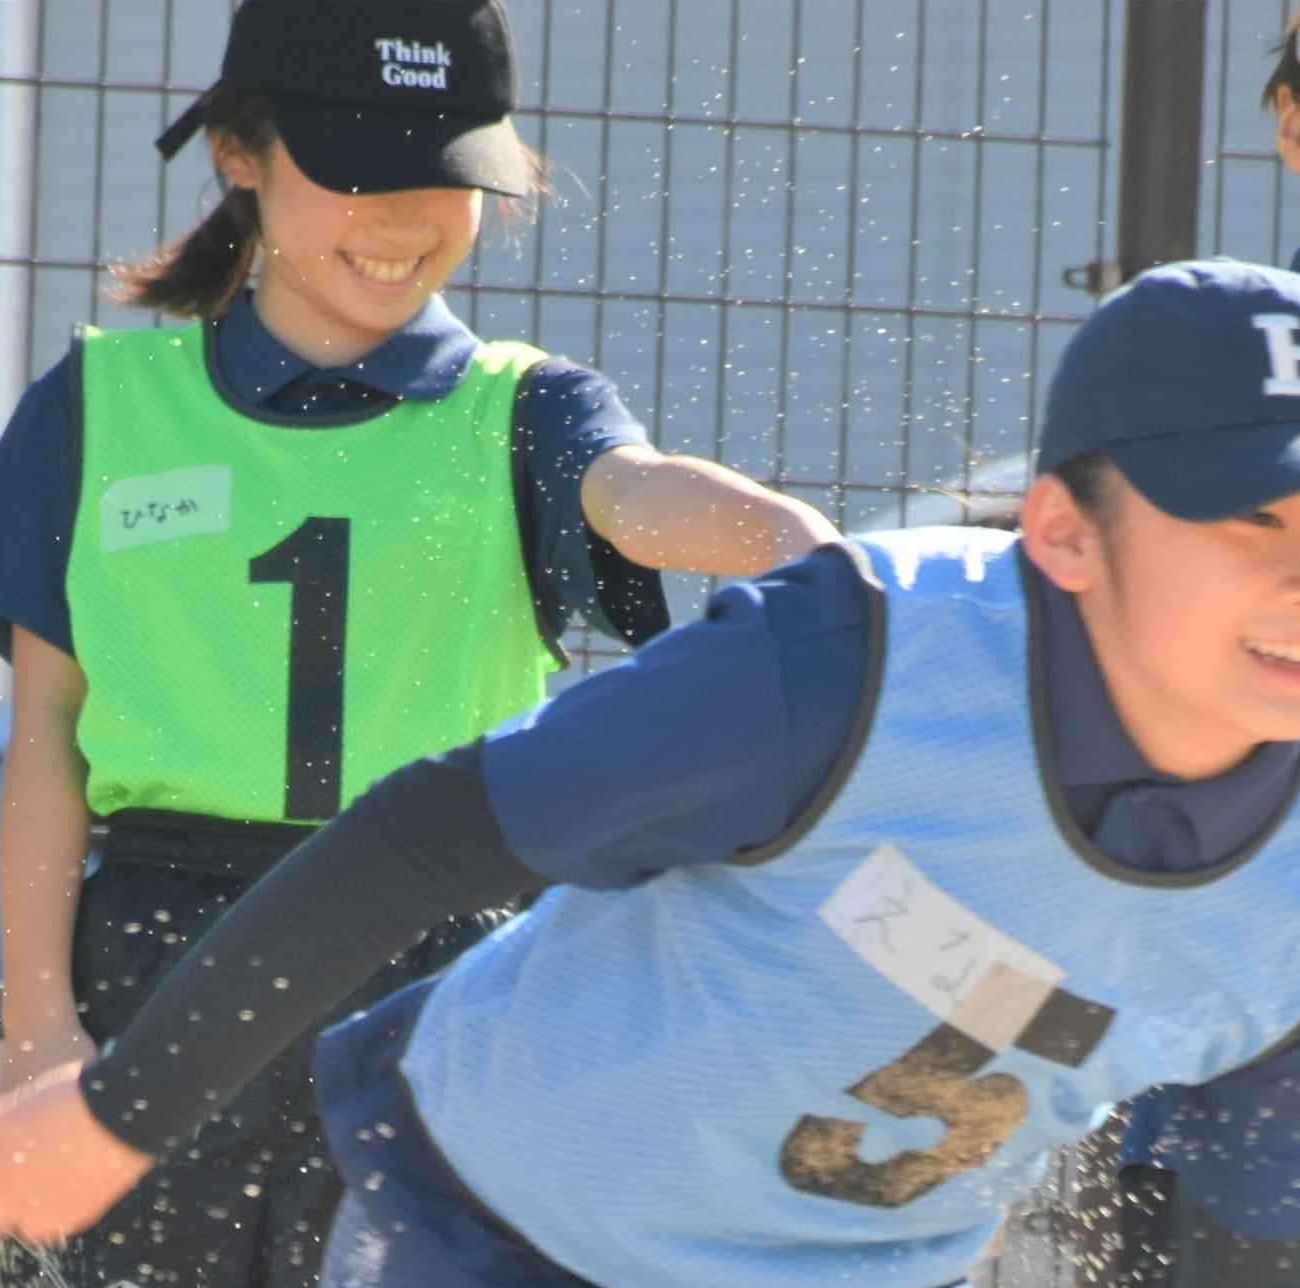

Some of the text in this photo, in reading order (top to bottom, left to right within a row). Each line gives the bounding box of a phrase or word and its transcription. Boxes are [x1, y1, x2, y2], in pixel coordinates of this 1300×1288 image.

[374, 38, 452, 66] Think
[382, 63, 447, 90] Good
[247, 515, 352, 820] 1
